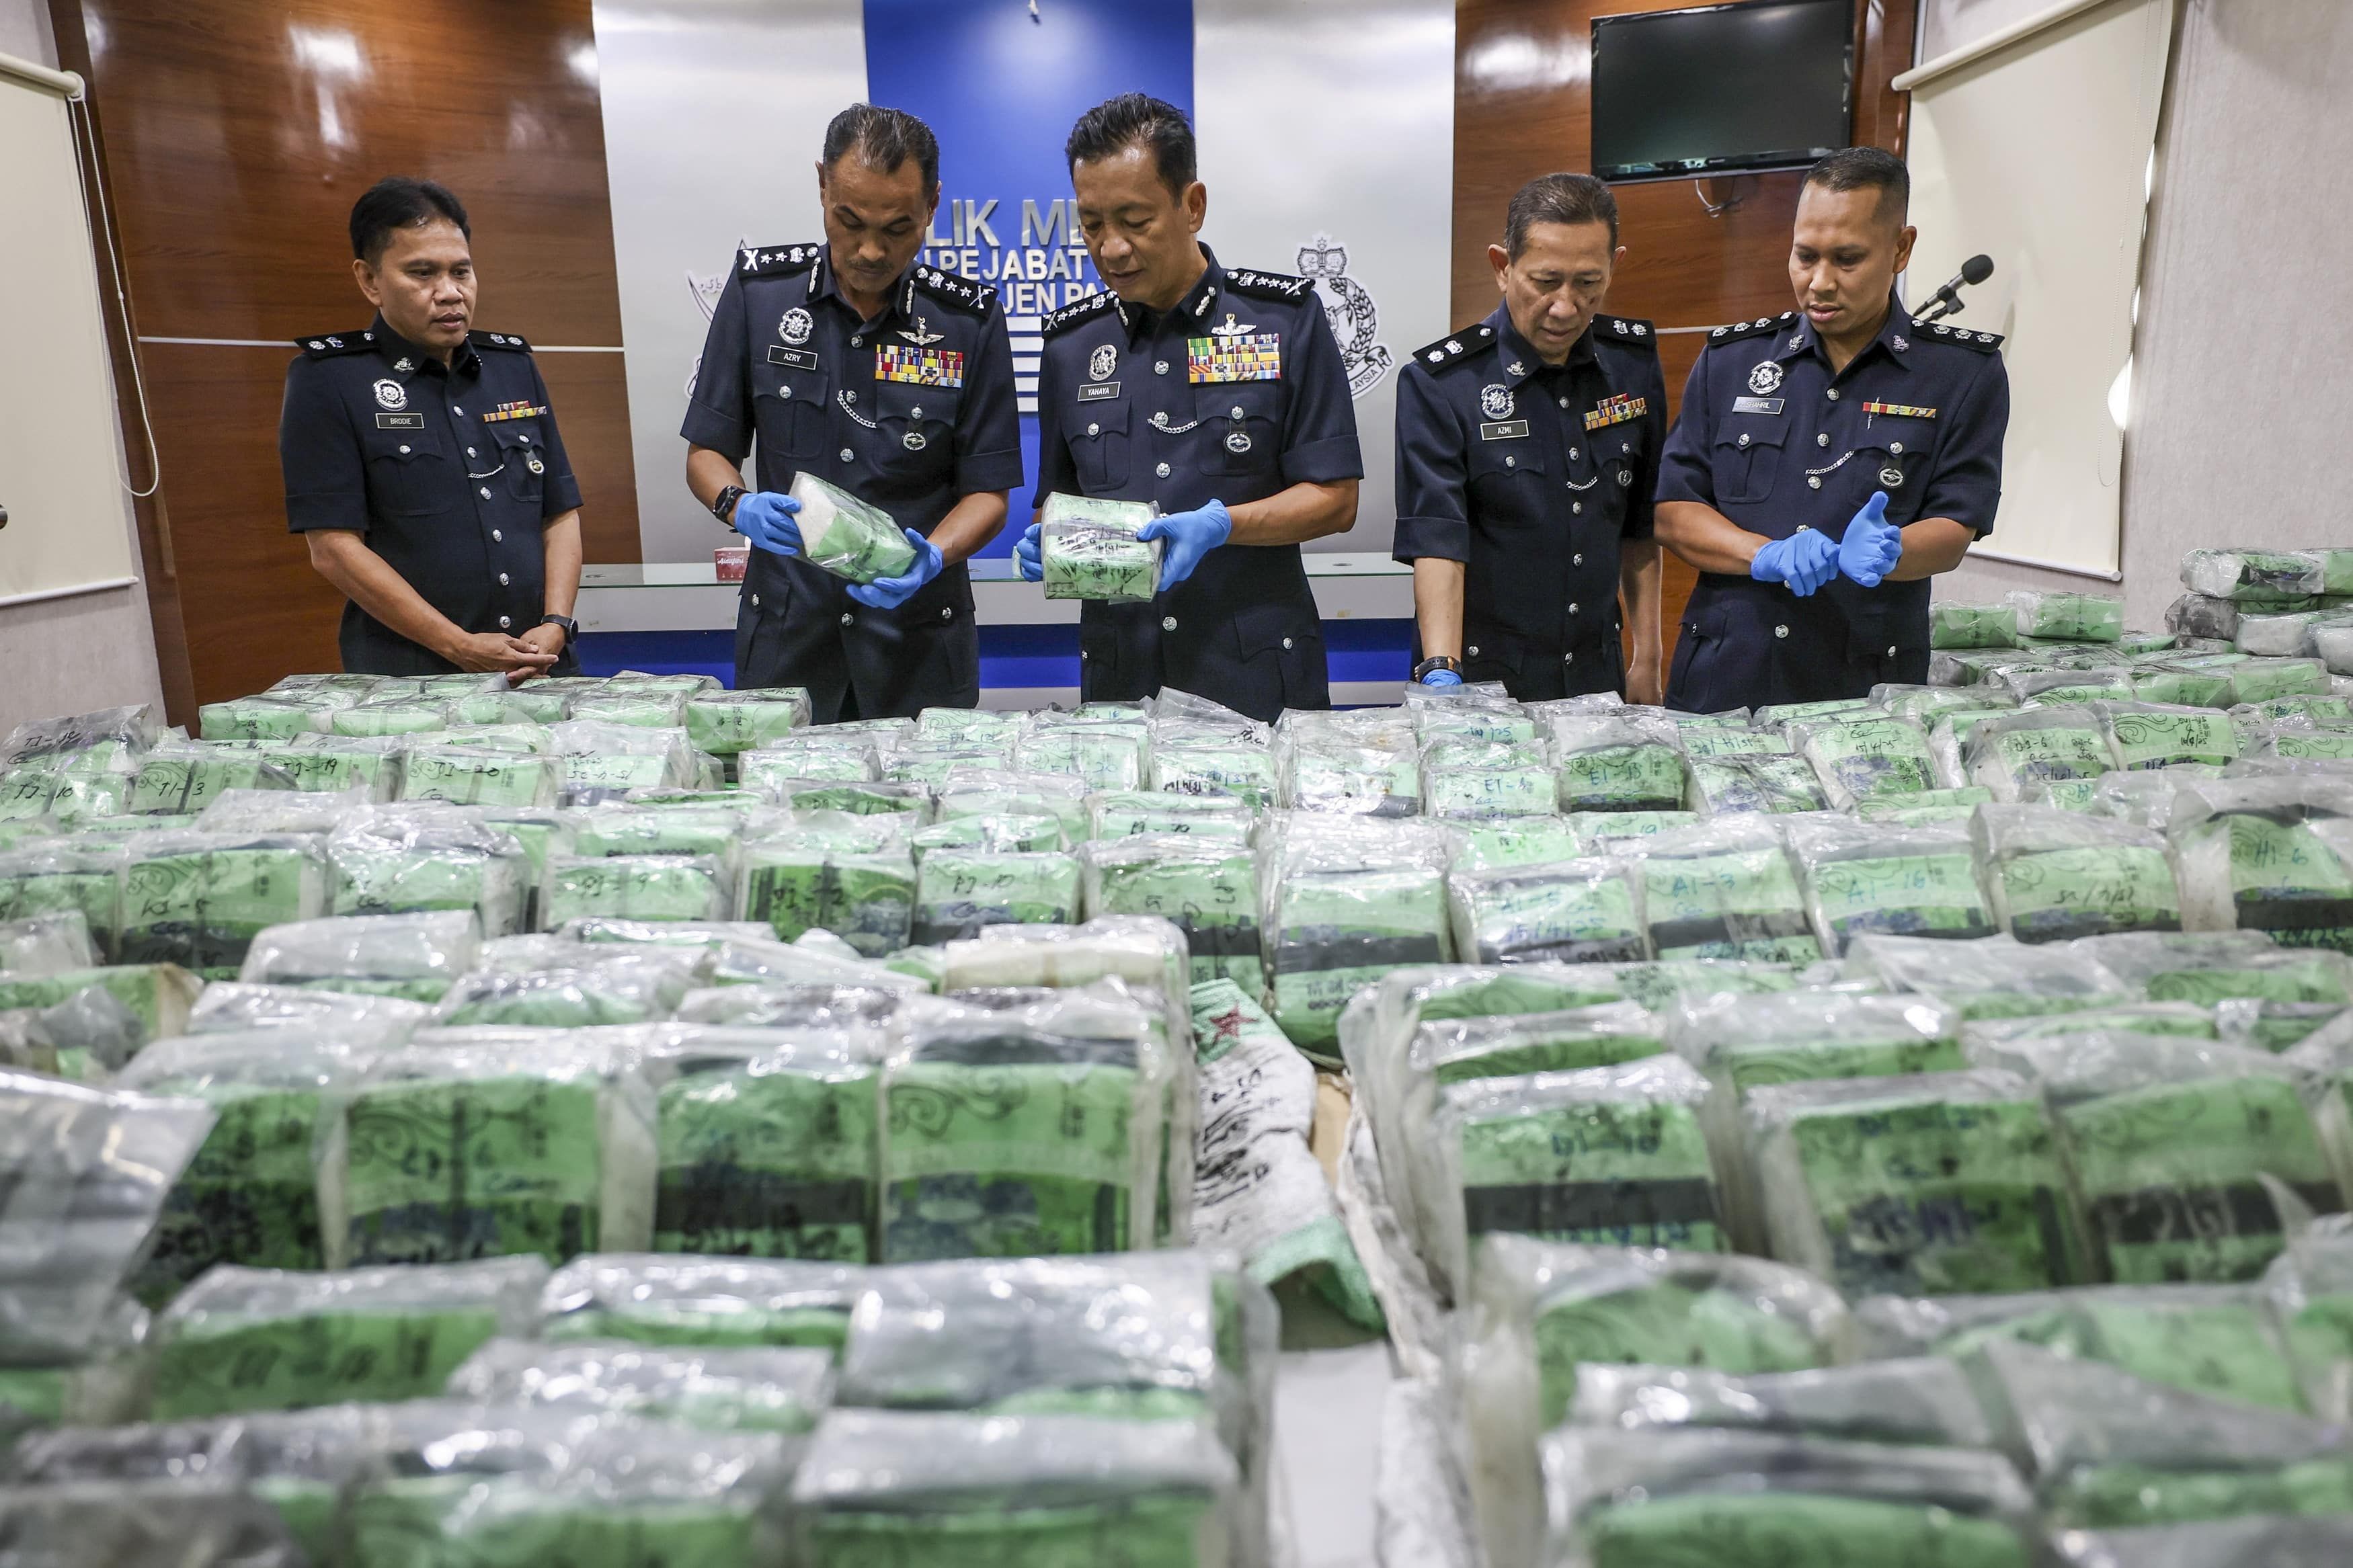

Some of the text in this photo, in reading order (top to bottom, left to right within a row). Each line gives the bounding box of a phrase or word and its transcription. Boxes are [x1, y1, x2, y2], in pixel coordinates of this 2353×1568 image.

[939, 249, 1088, 281] PEJABAT
[1004, 282, 1104, 315] JEN PA
[783, 352, 801, 363] AZRY
[1088, 386, 1110, 396] YAHAYA
[1497, 426, 1512, 435] AZMI
